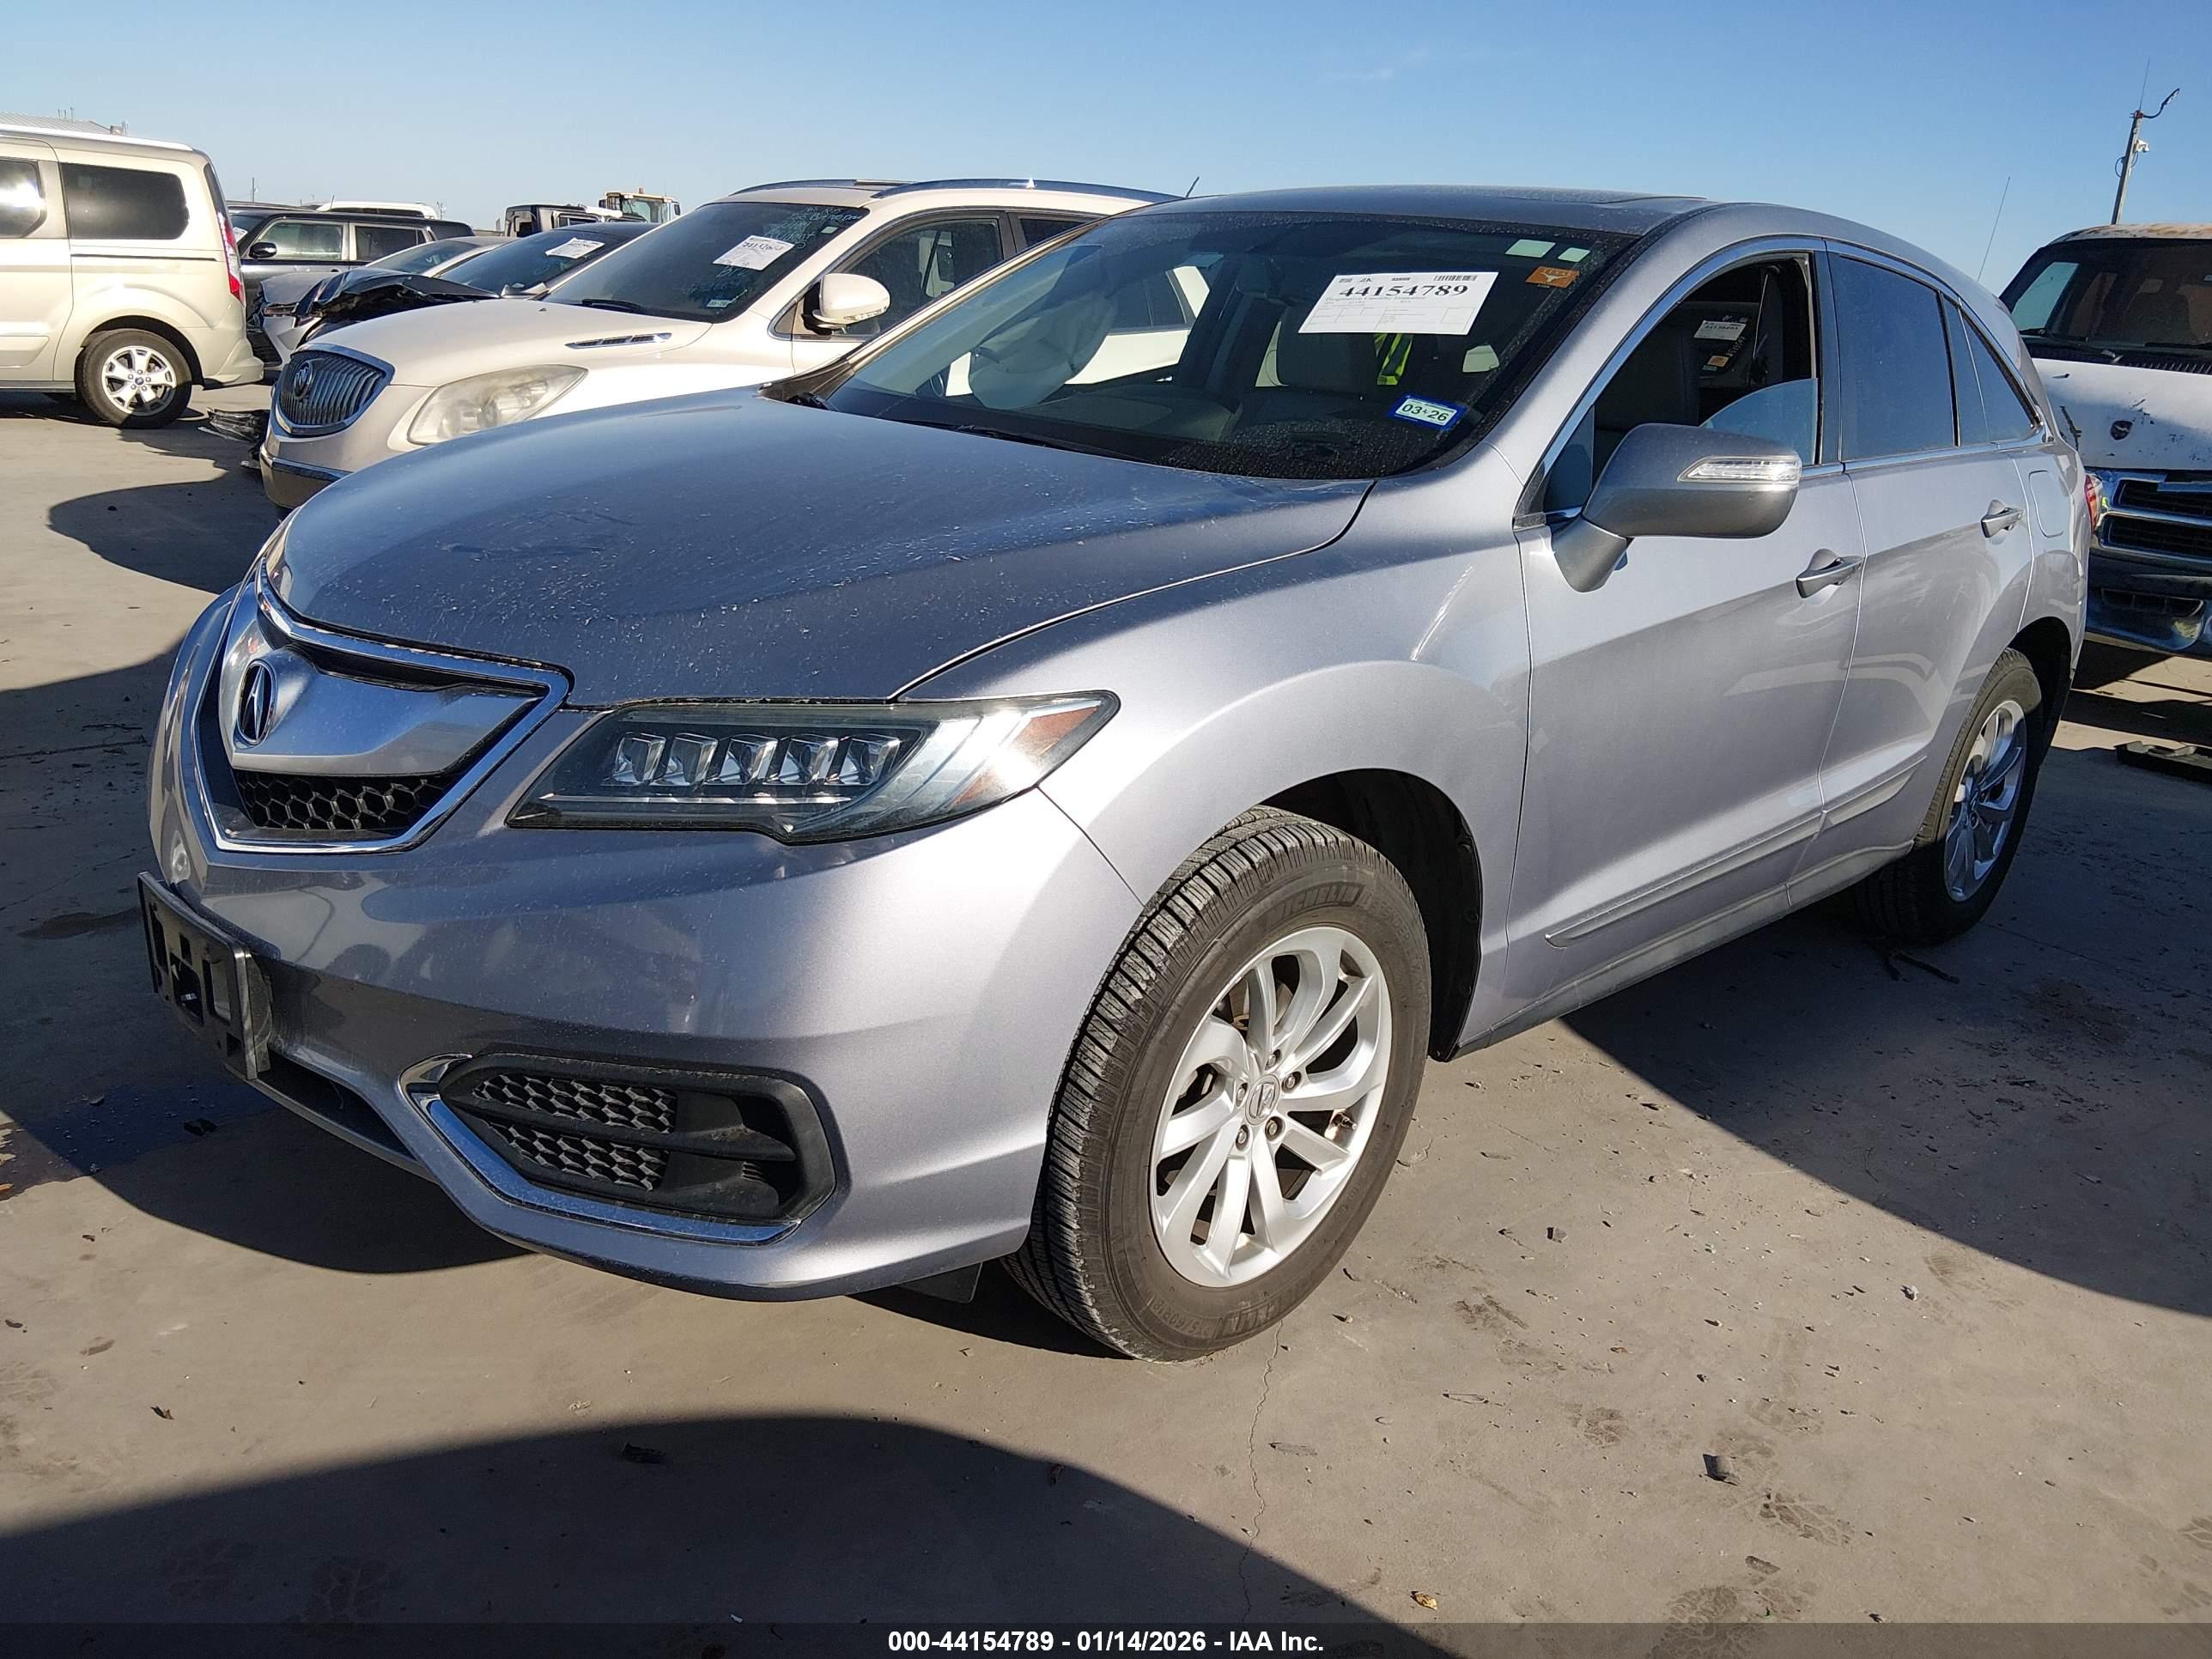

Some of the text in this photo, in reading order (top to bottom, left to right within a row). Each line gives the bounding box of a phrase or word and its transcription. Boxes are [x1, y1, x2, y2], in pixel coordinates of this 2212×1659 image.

[1339, 284, 1468, 297] 44154789
[1401, 404, 1449, 422] 03 26
